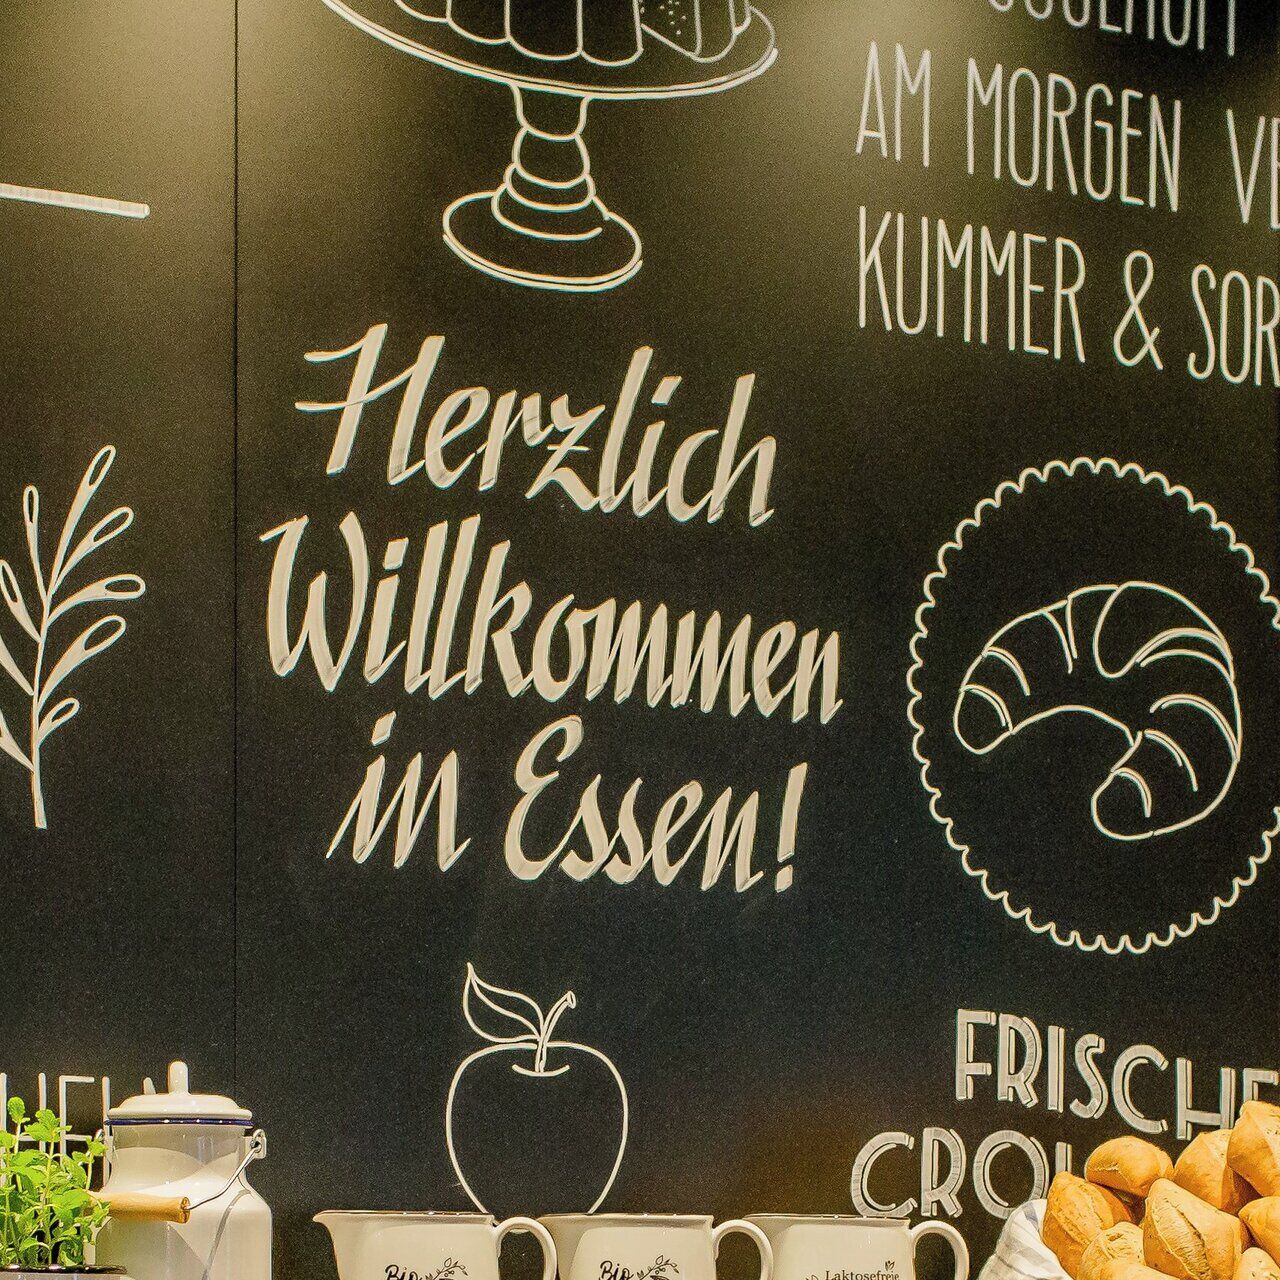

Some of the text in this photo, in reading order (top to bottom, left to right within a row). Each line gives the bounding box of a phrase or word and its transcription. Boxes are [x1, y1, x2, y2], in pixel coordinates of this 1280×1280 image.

[855, 40, 931, 168] AM
[966, 57, 1182, 212] MORGEN
[858, 205, 1086, 363] KUMMER
[1112, 250, 1163, 370] &
[295, 322, 778, 527] Herzlich
[258, 510, 843, 726] Willkommen
[325, 710, 809, 893] in Essen!
